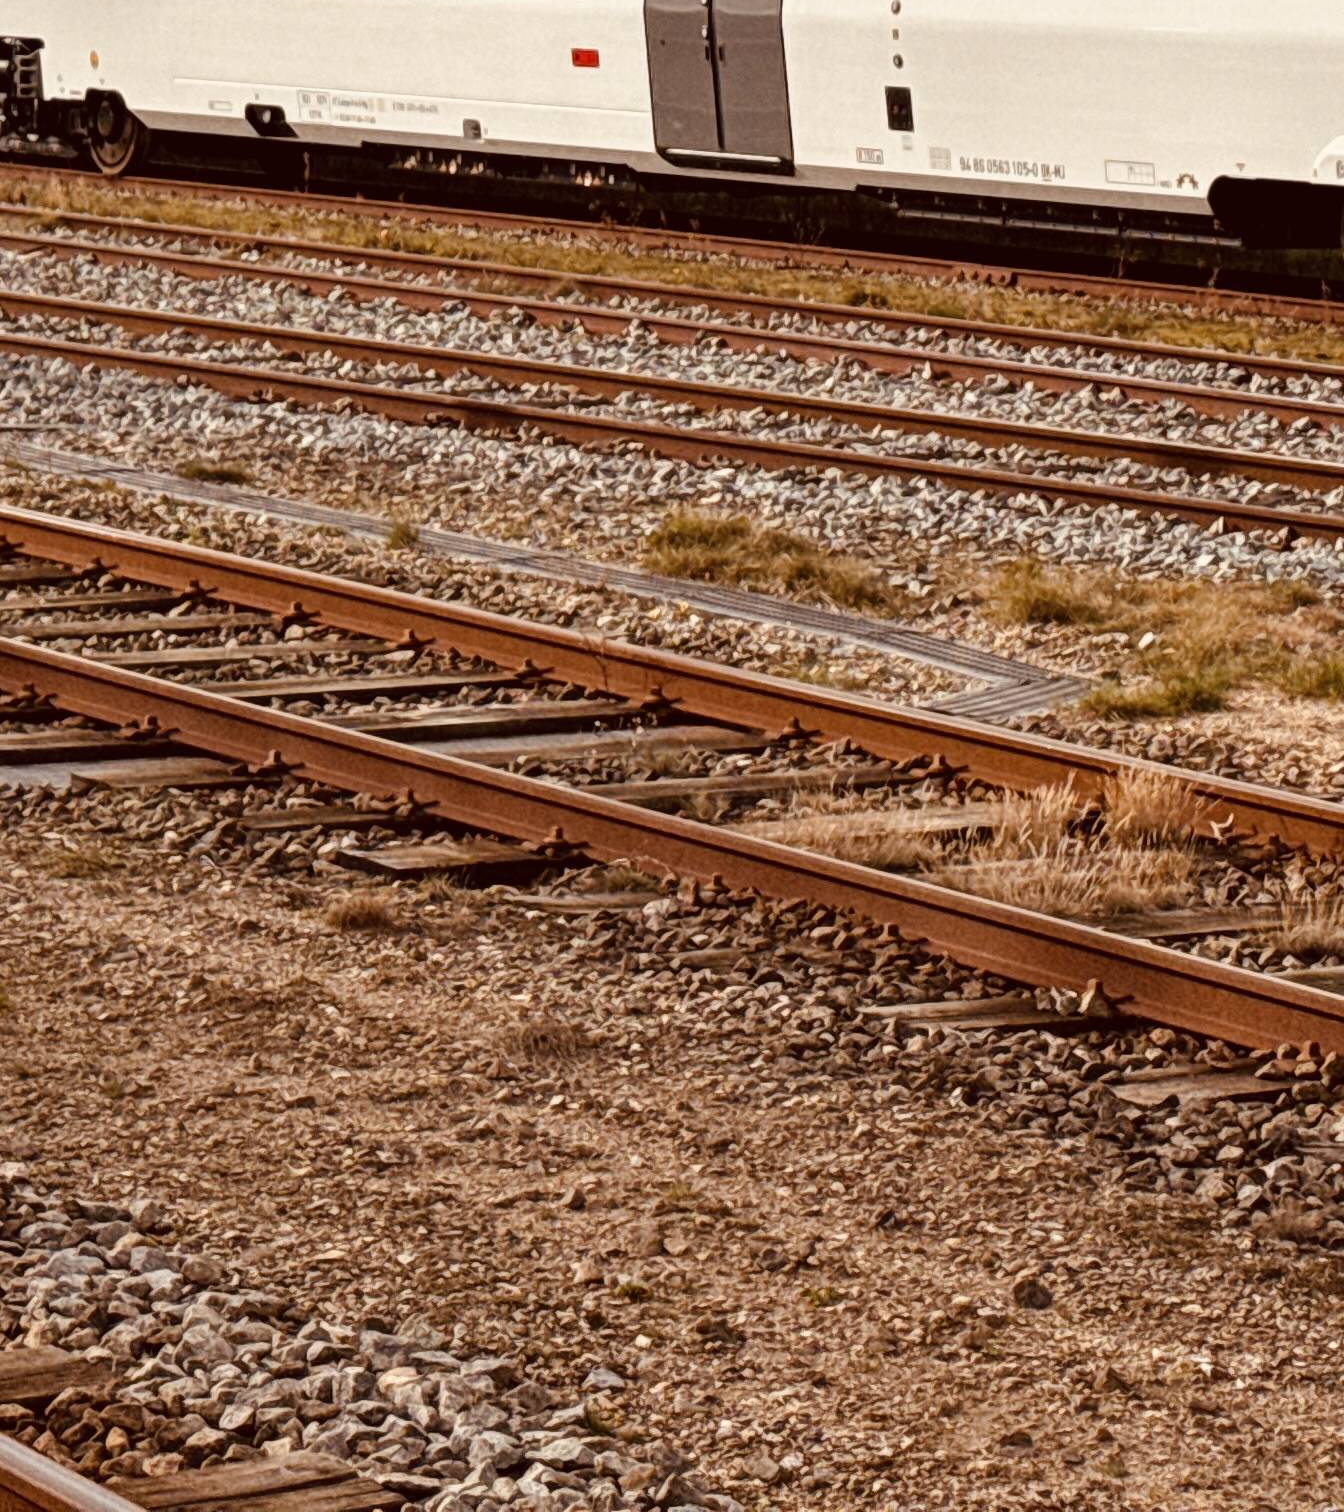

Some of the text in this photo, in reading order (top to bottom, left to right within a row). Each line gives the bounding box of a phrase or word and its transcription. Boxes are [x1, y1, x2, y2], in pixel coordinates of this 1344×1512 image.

[959, 156, 972, 171] 94
[973, 158, 985, 173] 86
[987, 159, 1010, 175] 0563
[1012, 160, 1038, 177] 105-0
